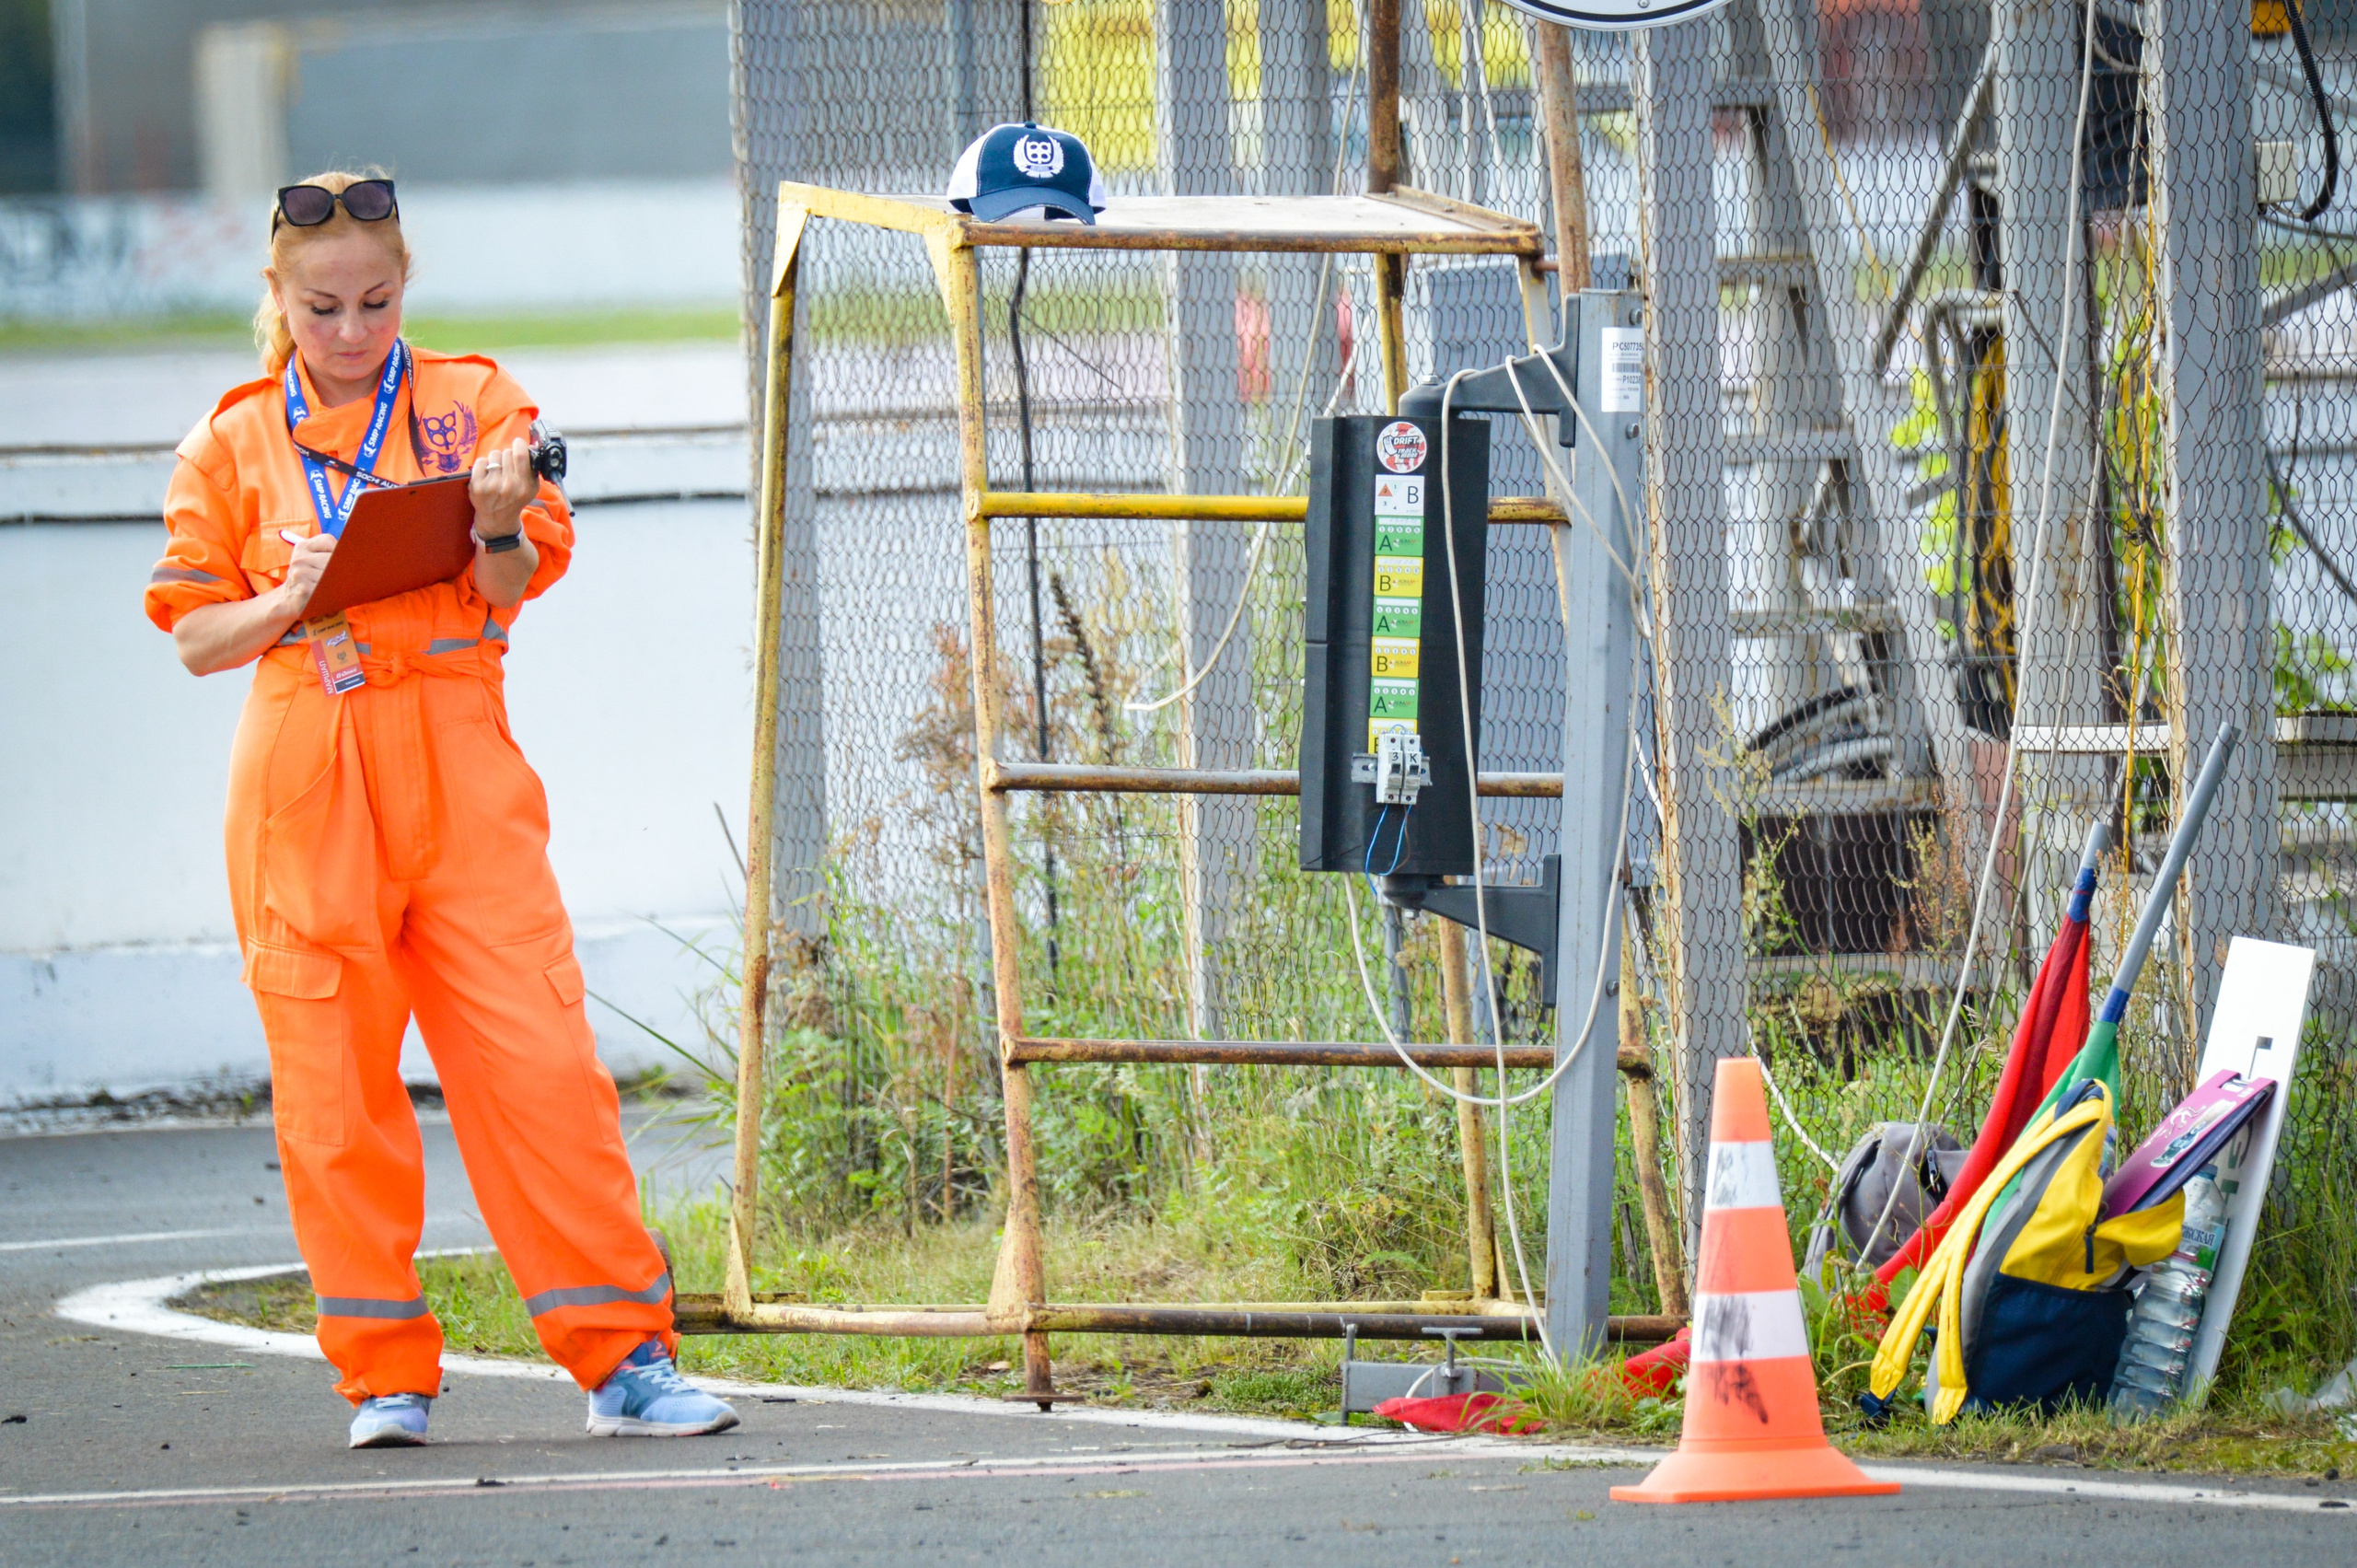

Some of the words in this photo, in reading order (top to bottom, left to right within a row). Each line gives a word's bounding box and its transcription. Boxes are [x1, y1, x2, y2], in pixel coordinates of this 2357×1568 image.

[287, 369, 297, 397] RACING
[388, 366, 397, 384] SMP
[368, 428, 379, 447] SMP
[375, 401, 388, 430] RACING
[1393, 436, 1418, 445] DRIFT
[356, 471, 380, 484] SOCHI
[314, 479, 324, 494] SMP
[319, 494, 332, 519] RACING
[343, 494, 354, 510] SMP
[1408, 485, 1419, 504] B
[1378, 535, 1392, 552] A
[1379, 575, 1391, 592] B
[1376, 615, 1390, 633] A
[1376, 656, 1388, 672] B
[1374, 696, 1387, 713] A
[2182, 1225, 2214, 1246] ЖСКАЯ
